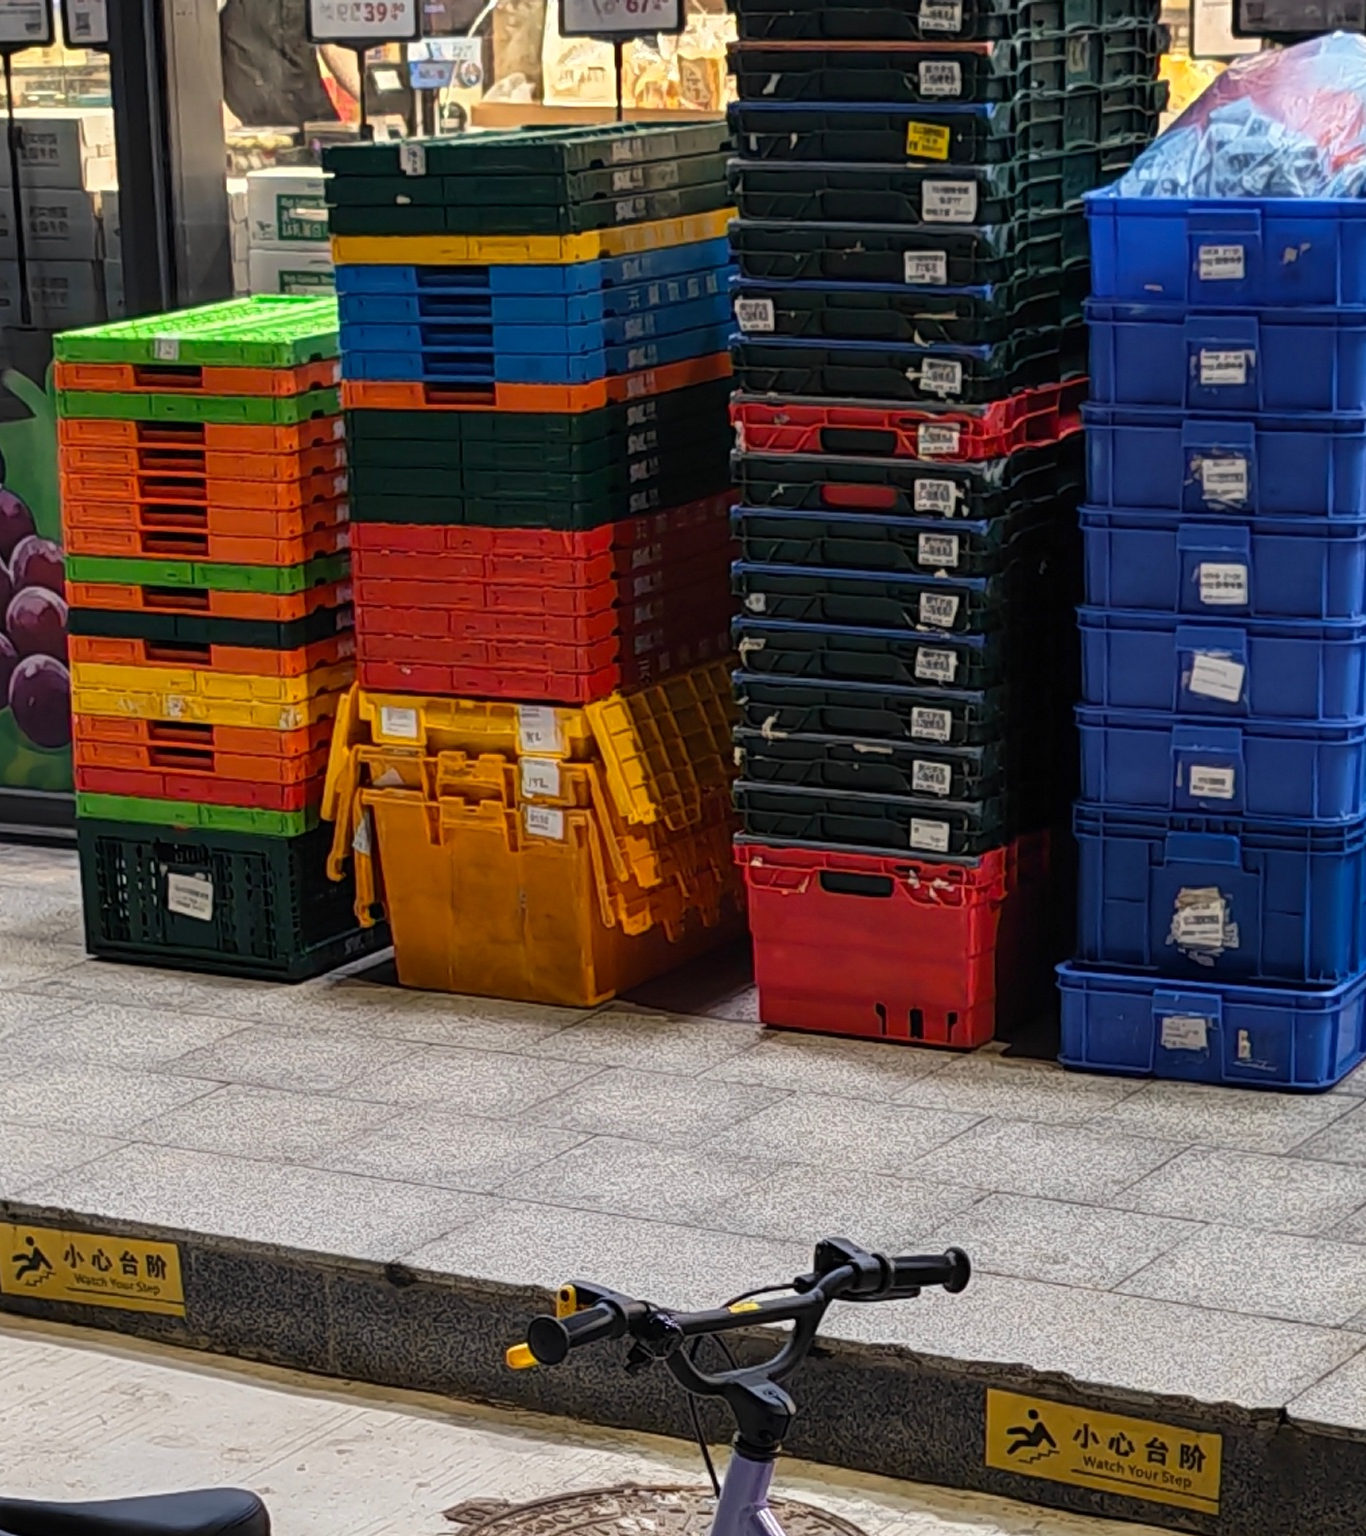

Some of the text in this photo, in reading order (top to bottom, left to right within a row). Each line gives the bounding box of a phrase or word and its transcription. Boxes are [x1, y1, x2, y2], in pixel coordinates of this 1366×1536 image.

[63, 1242, 168, 1281] 小心台阶
[73, 1273, 108, 1288] Watch
[110, 1278, 135, 1291] Your
[1072, 1422, 1208, 1474] 小心台阶
[1083, 1455, 1193, 1490] Watch Your Step
